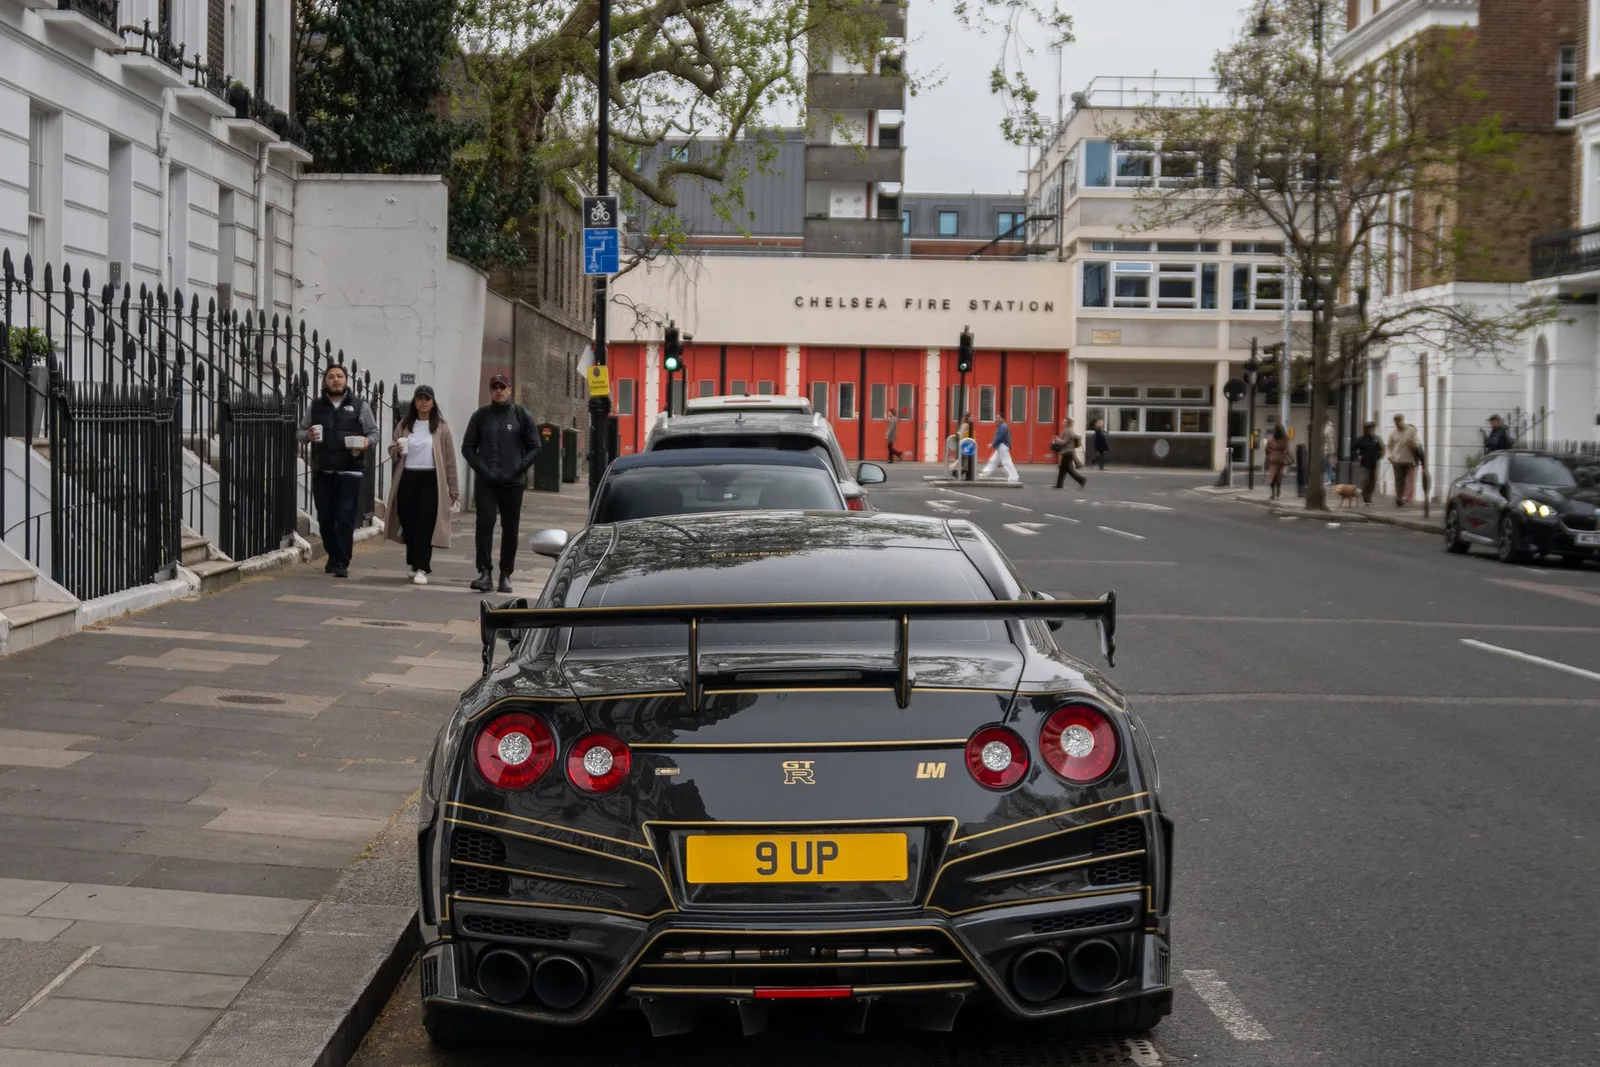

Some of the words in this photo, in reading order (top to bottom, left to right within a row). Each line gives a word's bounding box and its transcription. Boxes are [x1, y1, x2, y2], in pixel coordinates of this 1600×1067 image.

[794, 296, 887, 309] CHELSEA
[905, 298, 951, 310] FIRE
[969, 299, 1054, 311] STATION
[782, 760, 815, 768] GT
[916, 762, 947, 779] LM
[755, 841, 778, 875] 9
[790, 840, 839, 875] UP
